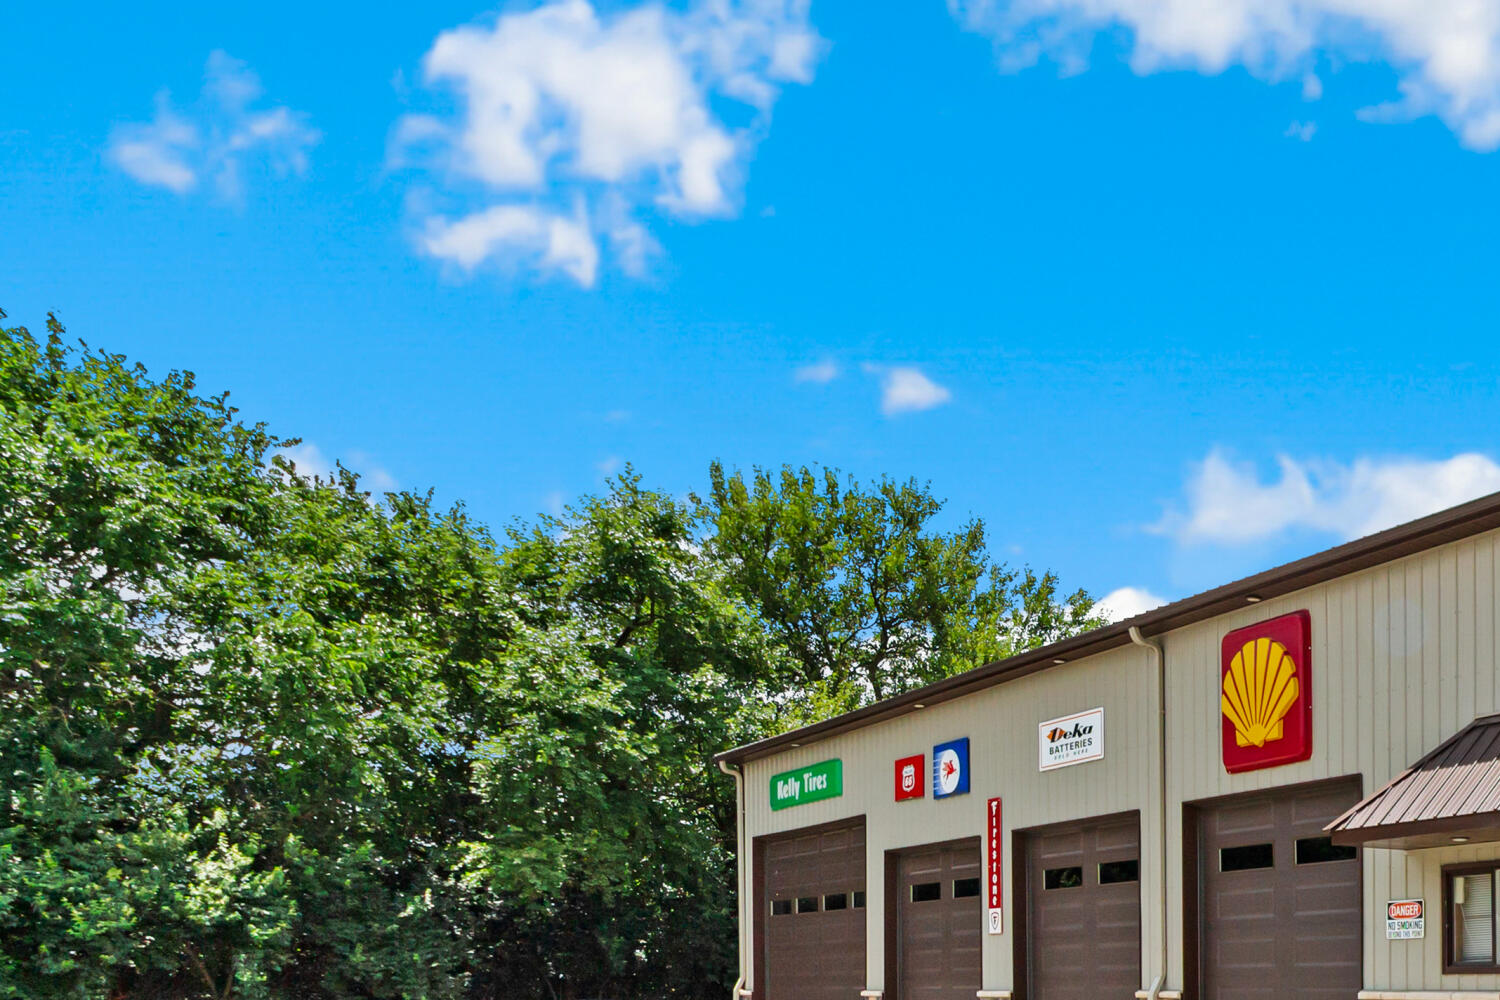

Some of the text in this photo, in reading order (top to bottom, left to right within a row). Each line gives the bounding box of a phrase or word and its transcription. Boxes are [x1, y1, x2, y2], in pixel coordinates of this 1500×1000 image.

[1049, 738, 1093, 755] BATTERIES
[777, 772, 827, 801] Kelly Tires
[1391, 904, 1418, 916] DANGER
[1388, 920, 1423, 931] NO SMOKING
